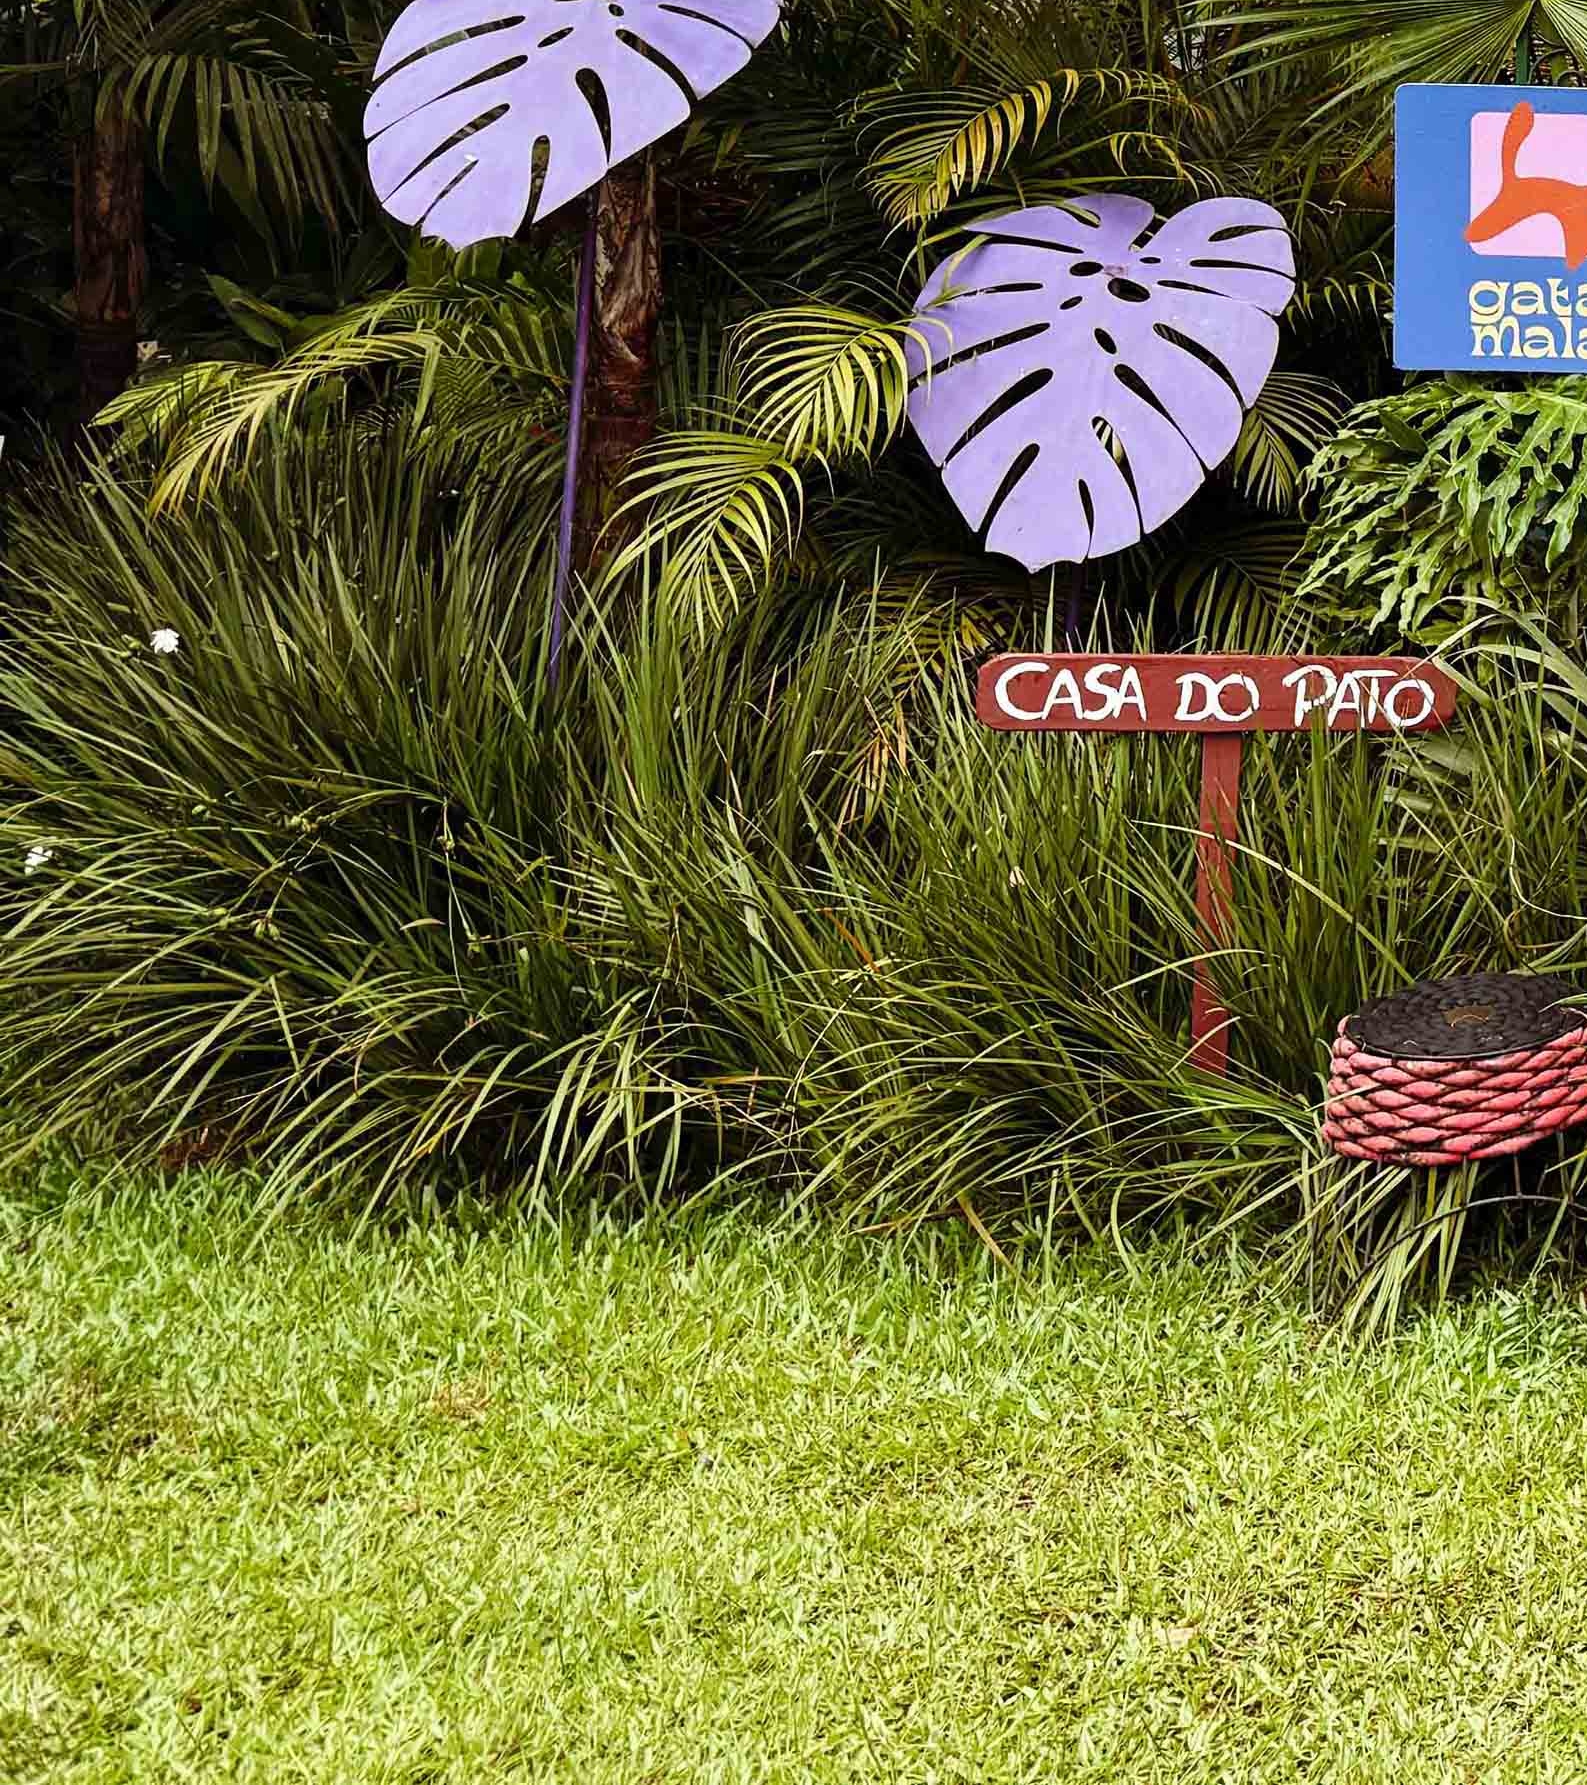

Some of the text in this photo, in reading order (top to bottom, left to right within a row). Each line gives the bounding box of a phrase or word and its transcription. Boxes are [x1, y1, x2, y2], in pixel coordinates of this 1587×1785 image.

[993, 660, 1436, 729] CASA DO PATO
